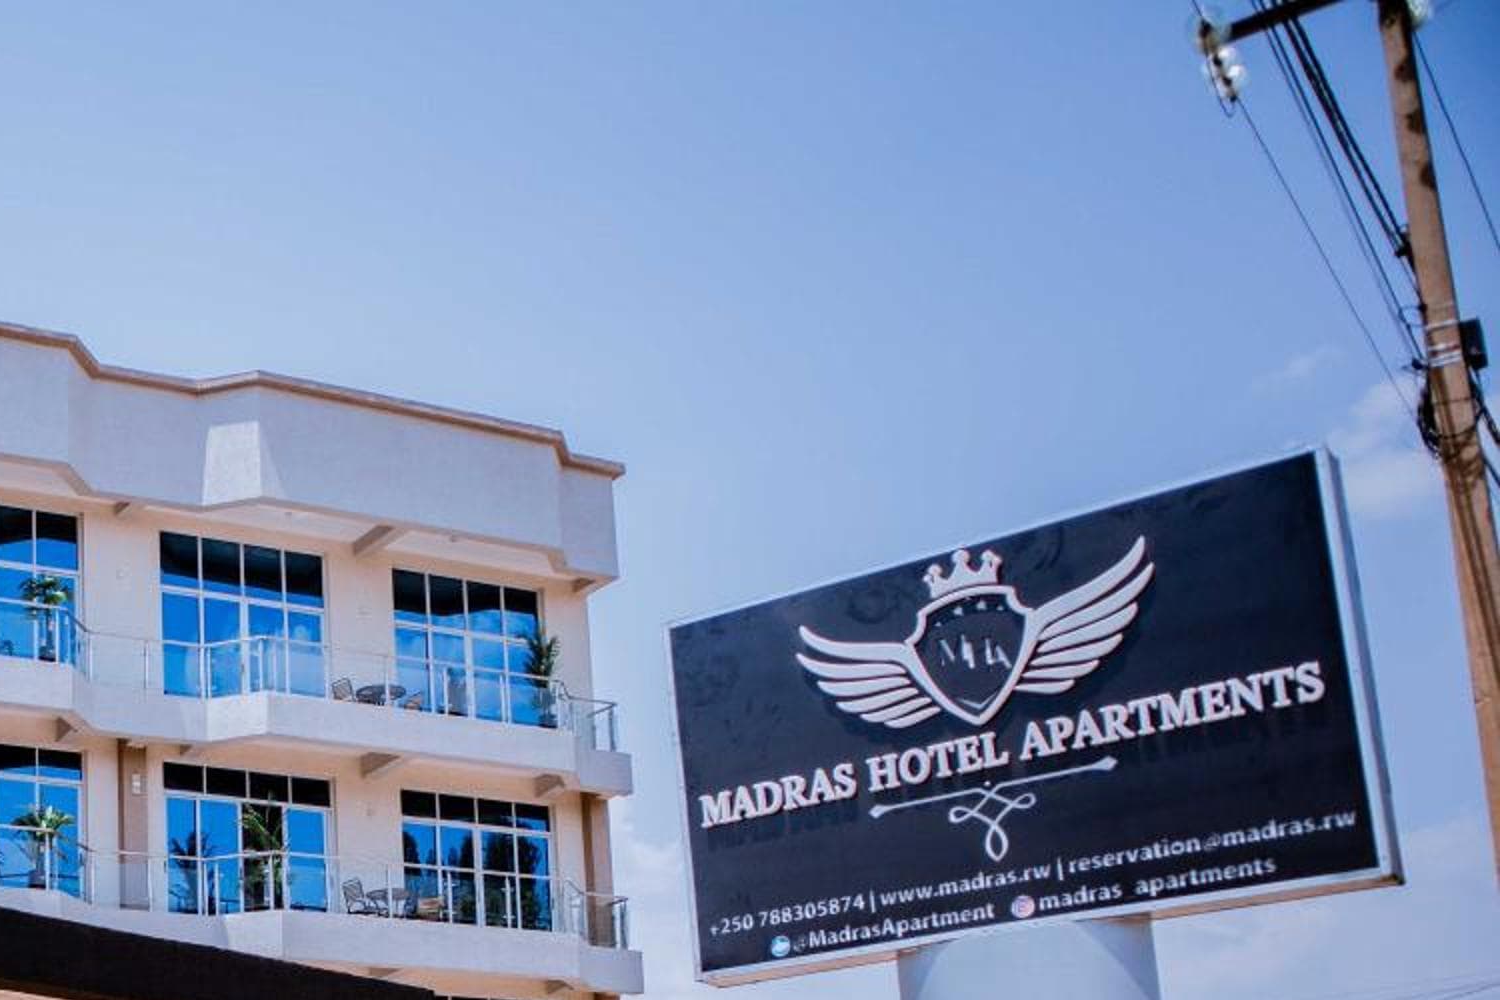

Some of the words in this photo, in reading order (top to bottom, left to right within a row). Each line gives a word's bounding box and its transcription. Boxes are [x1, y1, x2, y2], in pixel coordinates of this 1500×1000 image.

[699, 763, 858, 828] MADRAS
[866, 731, 1008, 792] HOTEL
[1019, 660, 1326, 761] APARTMENTS
[710, 913, 753, 936] +250
[759, 896, 865, 925] 788305874
[880, 863, 1050, 907] www.madras.rw
[1068, 810, 1357, 875] reservation@madras.rw
